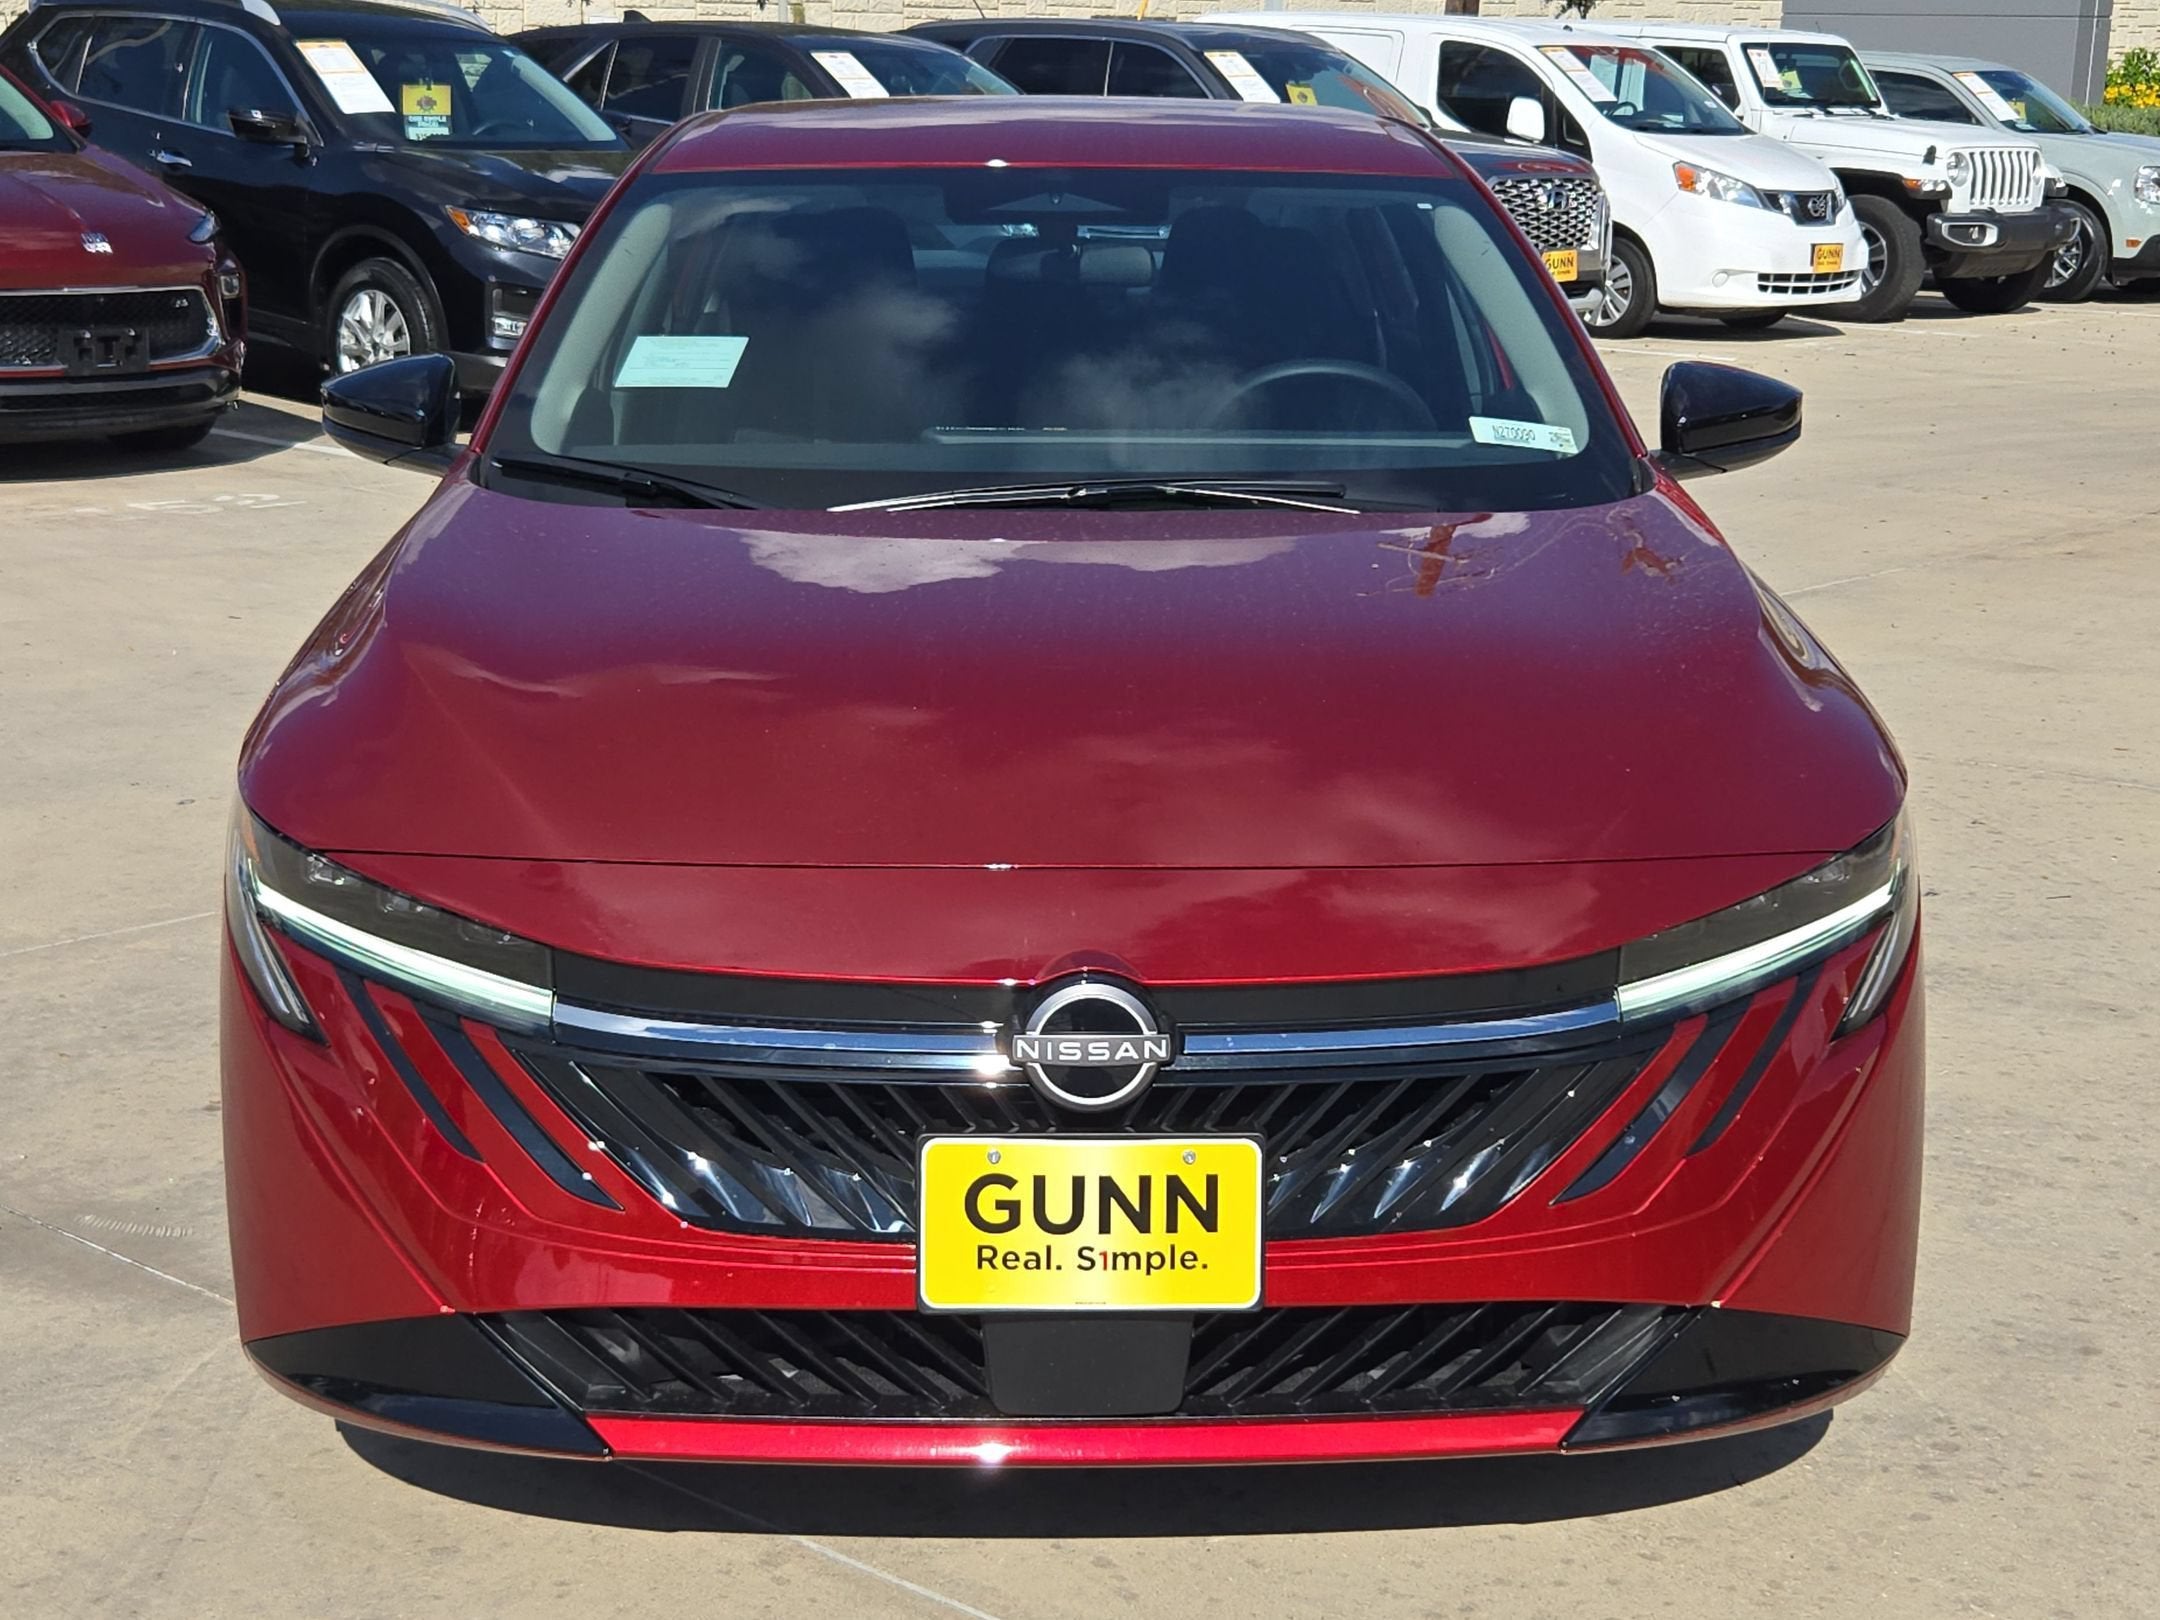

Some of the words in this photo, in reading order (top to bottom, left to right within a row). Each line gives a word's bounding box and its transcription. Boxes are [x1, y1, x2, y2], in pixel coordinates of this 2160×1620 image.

[1016, 1039, 1167, 1061] NISSAN
[964, 1173, 1219, 1235] GUNN
[977, 1244, 1062, 1270] Real.
